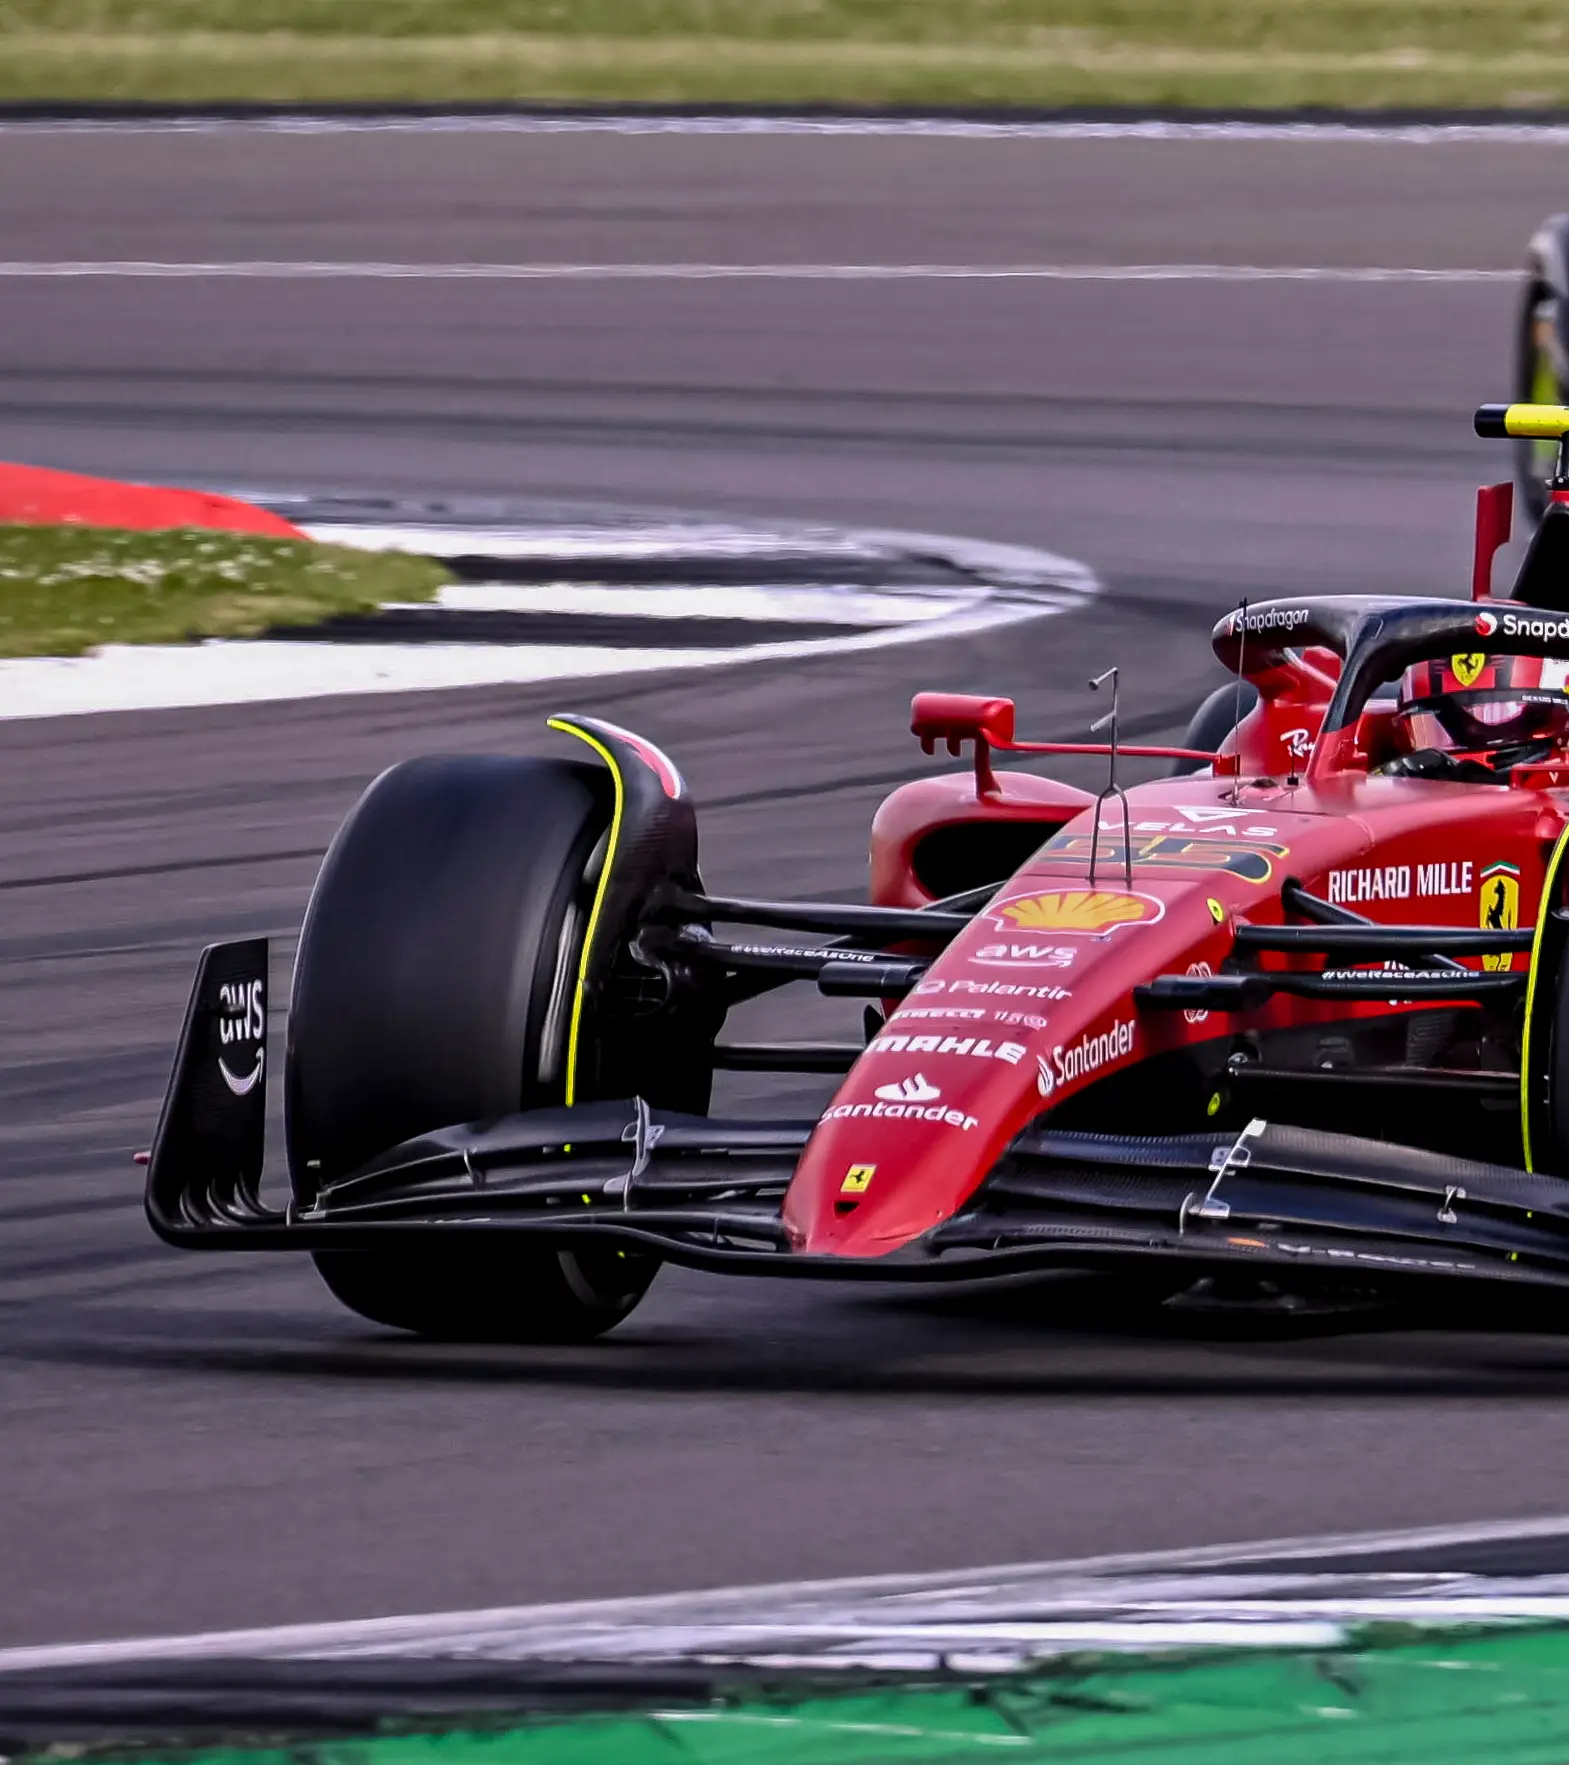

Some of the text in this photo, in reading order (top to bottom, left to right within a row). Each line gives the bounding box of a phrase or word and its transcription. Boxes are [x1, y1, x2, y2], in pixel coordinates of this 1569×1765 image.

[1235, 608, 1309, 634] Snapdragon
[1096, 820, 1278, 838] VELAS
[1045, 834, 1290, 884] 55
[1328, 861, 1473, 902] RICHARD MILLE
[976, 943, 1078, 962] aws
[949, 980, 1073, 1001] Palantir
[220, 979, 264, 1045] aws
[868, 1035, 1027, 1065] MAHLE
[1053, 1018, 1136, 1088] Santander
